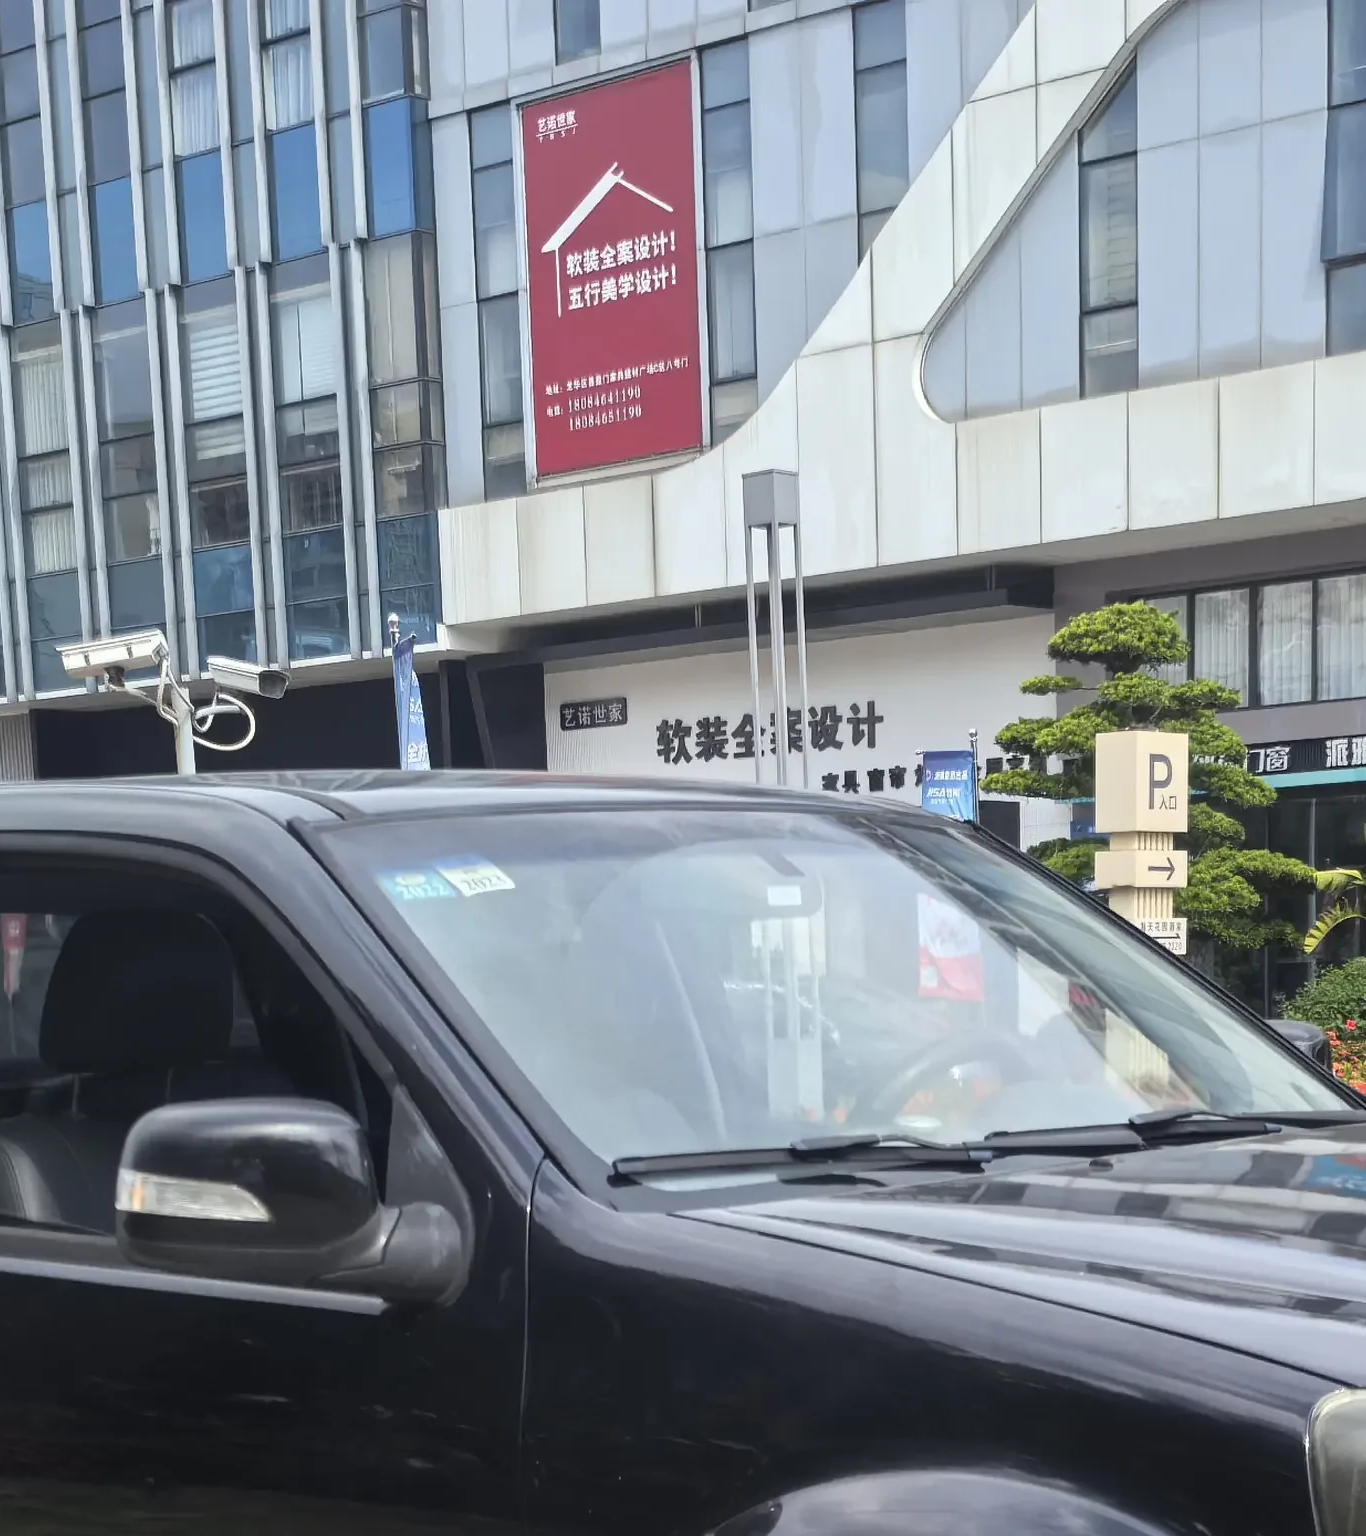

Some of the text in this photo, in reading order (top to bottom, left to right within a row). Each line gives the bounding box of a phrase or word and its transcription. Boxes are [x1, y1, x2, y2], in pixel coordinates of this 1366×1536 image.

[566, 230, 676, 278] 软装全案设计!
[567, 262, 677, 311] 五行美学设计!
[562, 702, 623, 727] 艺诺世家
[656, 700, 884, 765] 软装全案设计
[1149, 753, 1173, 810] P
[1159, 795, 1177, 810] 入口
